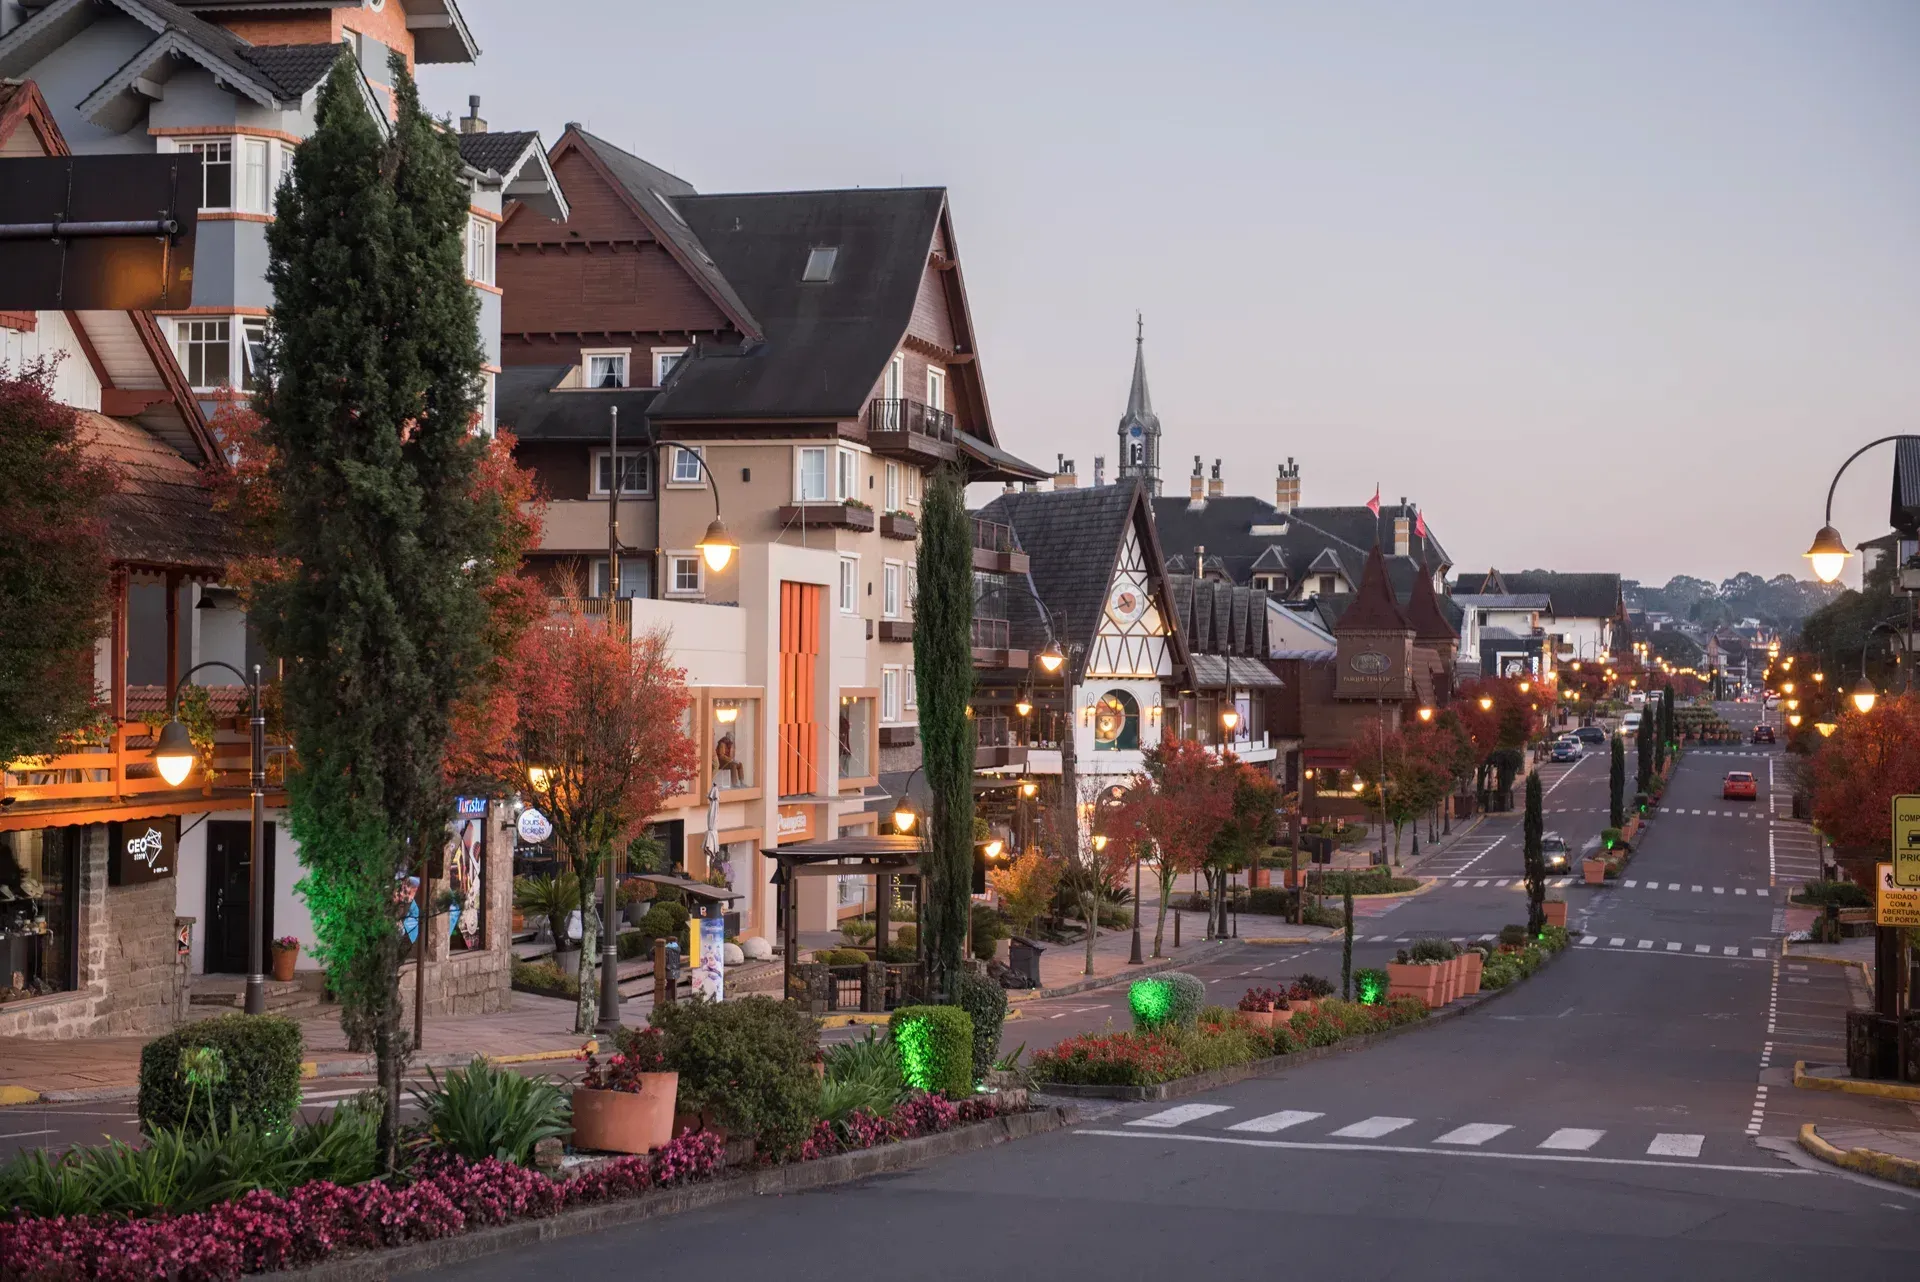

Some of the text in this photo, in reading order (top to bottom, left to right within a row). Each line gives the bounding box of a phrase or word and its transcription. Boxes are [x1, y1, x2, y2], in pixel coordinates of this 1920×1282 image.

[458, 797, 487, 814] Turistur
[128, 838, 147, 854] GEO
[1885, 892, 1918, 900] CUIDADO
